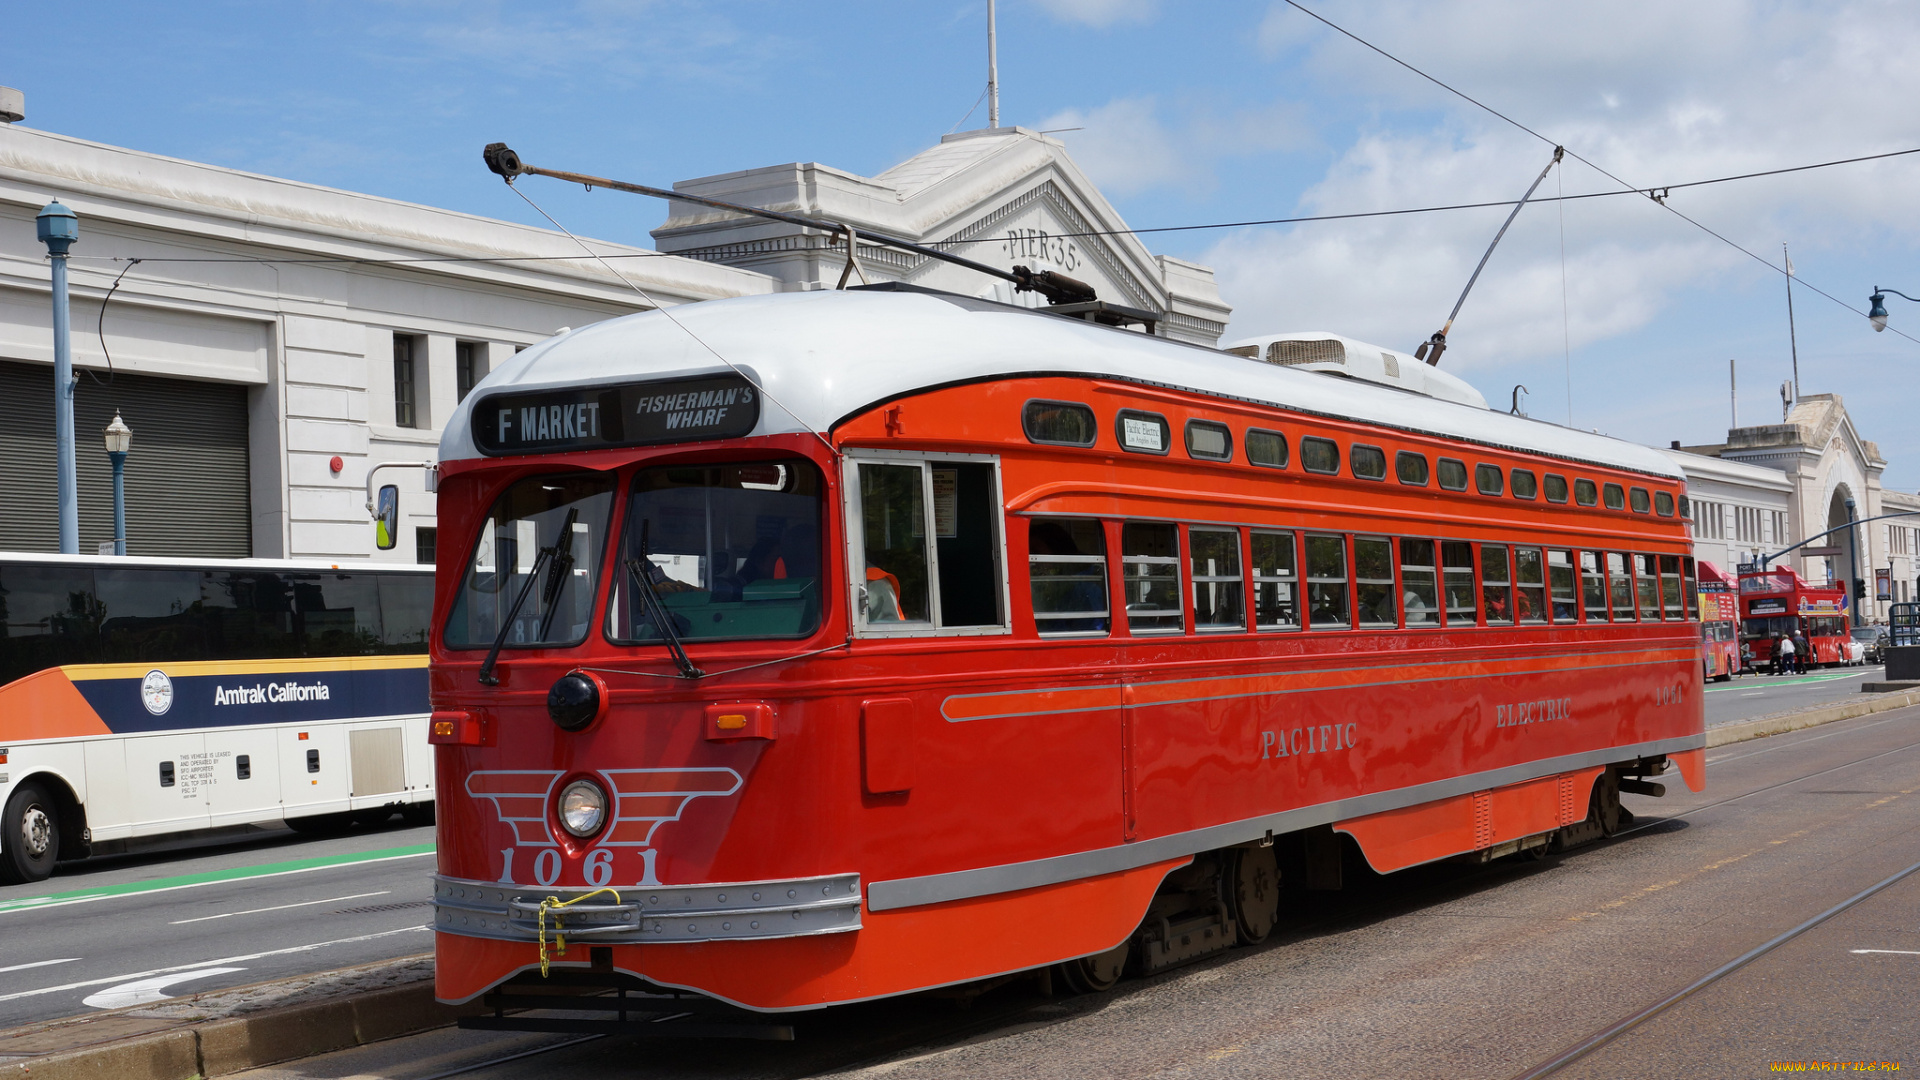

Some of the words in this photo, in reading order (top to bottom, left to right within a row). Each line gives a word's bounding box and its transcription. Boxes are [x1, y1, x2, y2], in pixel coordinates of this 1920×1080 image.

[1007, 228, 1050, 261] PIER
[1055, 236, 1076, 272] 35
[636, 387, 753, 414] FISHERMAN'S
[499, 409, 511, 443] F
[521, 402, 600, 442] MARKET
[665, 408, 728, 430] WHARF
[1126, 420, 1141, 435] Pacific
[1142, 423, 1160, 437] Electric
[214, 684, 267, 706] Amtrak
[267, 681, 330, 703] California
[1656, 685, 1682, 706] 1061
[1261, 722, 1358, 760] PACIFIC
[1496, 698, 1572, 728] ELECTRIC
[497, 847, 663, 886] 1061
